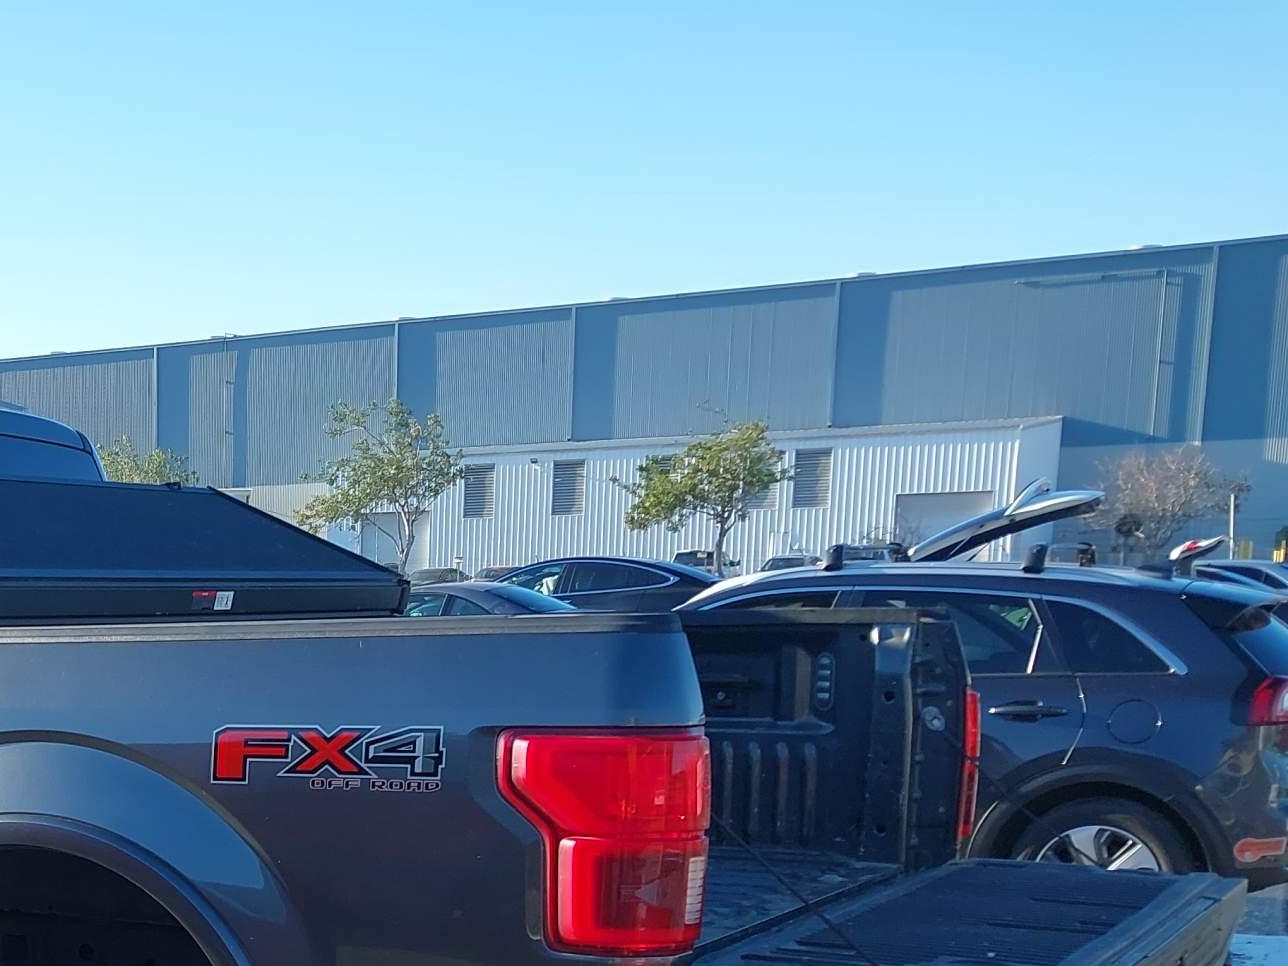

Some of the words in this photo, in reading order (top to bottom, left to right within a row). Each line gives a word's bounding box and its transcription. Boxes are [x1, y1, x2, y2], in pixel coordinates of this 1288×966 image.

[211, 724, 447, 784] FX4
[310, 778, 361, 790] OFF
[370, 780, 441, 792] ROAD
